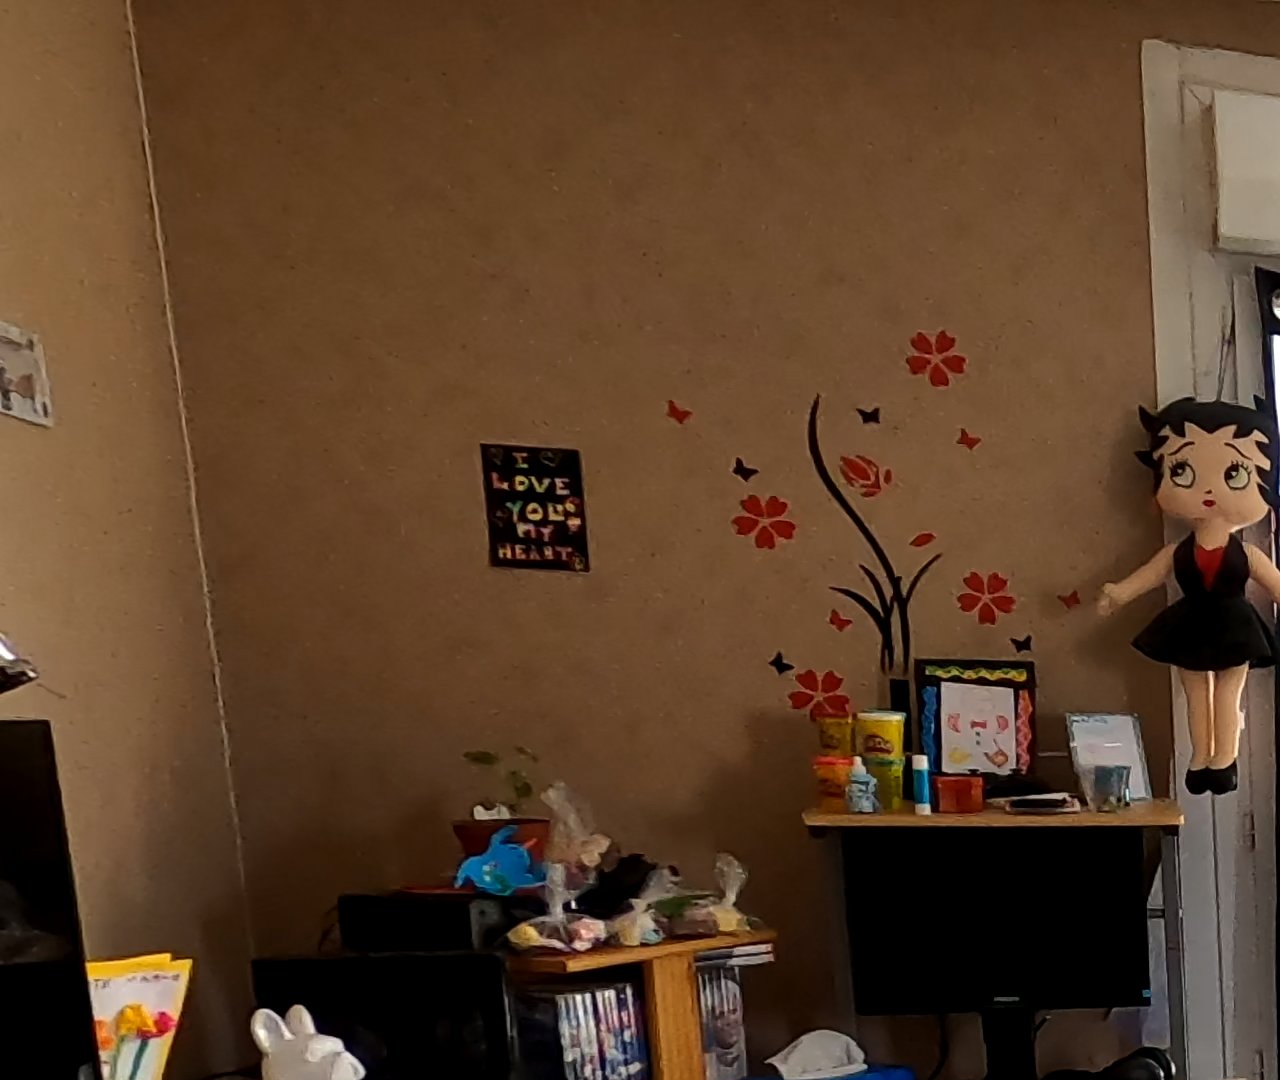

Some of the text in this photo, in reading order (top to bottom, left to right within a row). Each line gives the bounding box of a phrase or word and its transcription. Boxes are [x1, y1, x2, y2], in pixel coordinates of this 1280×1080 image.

[512, 452, 529, 468] I
[490, 472, 571, 495] LOVE
[497, 543, 572, 561] HEART
